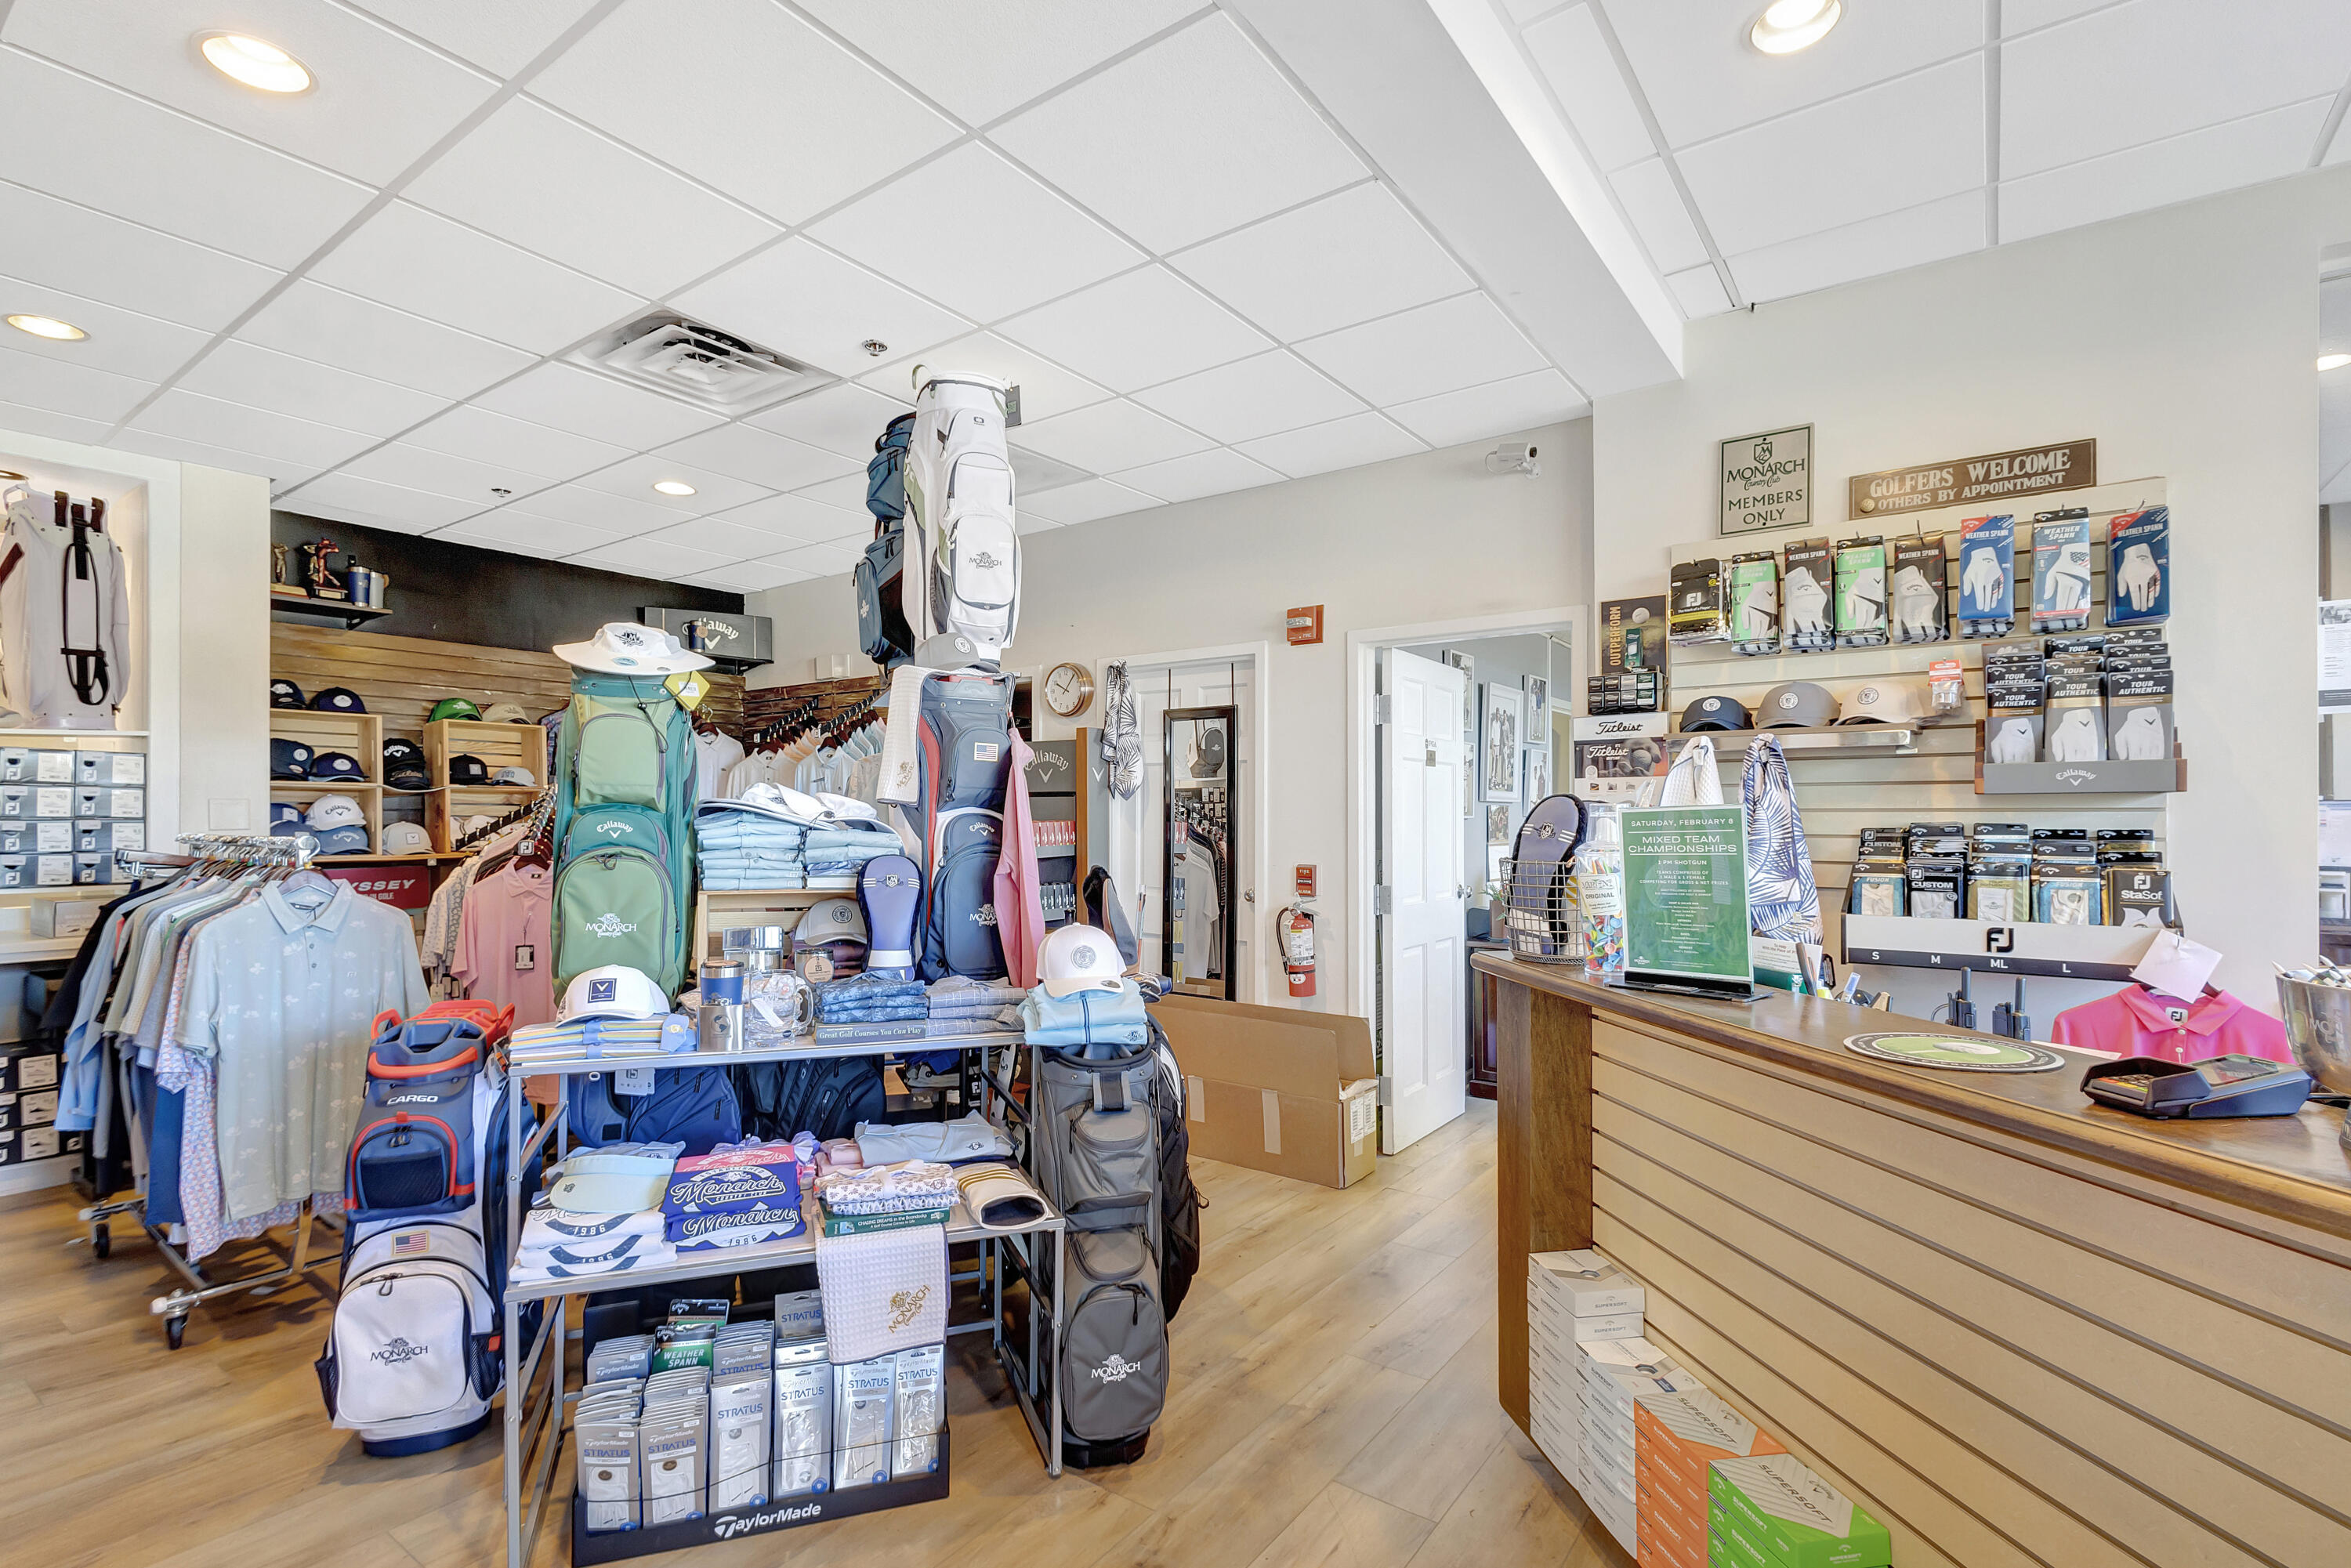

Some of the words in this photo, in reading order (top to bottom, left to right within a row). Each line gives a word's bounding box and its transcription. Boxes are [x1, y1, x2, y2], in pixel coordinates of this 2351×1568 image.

[1726, 458, 1805, 483] MONARCH
[1870, 468, 1954, 498] GOLFERS
[1967, 448, 2071, 482] WELCOME
[1744, 479, 1766, 491] Country
[1767, 476, 1780, 487] Club
[1878, 493, 1931, 510] OTHERS
[1937, 488, 1956, 502] BY
[1962, 472, 2067, 498] APPOINTMENT
[1729, 490, 1802, 511] MEMBERS
[1743, 508, 1785, 524] ONLY
[2045, 526, 2080, 534] WEATHER
[2117, 527, 2142, 538] WEATHER
[969, 557, 1002, 566] MONARCH
[1686, 592, 1701, 607] FJ
[1610, 606, 1621, 666] OUTPERFORM
[1596, 721, 1643, 734] Titleist
[1587, 744, 1629, 759] Titleist
[6, 768, 21, 780] FJ
[84, 770, 96, 781] FJ
[2056, 768, 2097, 780] Callaway
[5, 802, 20, 814] FJ
[82, 803, 95, 814] FJ
[325, 805, 352, 815] Callaway
[596, 820, 633, 833] Callaway
[969, 822, 994, 833] Callaway
[1865, 831, 1874, 839] FJ
[5, 838, 20, 851] FJ
[82, 838, 96, 849] FJ
[521, 844, 531, 853] FJ
[5, 872, 20, 884] FJ
[80, 870, 96, 883] FJ
[2134, 875, 2150, 889] FJ
[2121, 890, 2162, 900] StaSof
[585, 923, 636, 932] MONARCH
[1987, 928, 2014, 953] FJ
[1872, 951, 1879, 960] S
[1931, 955, 1940, 964] M
[1991, 958, 2008, 969] ML
[2063, 963, 2070, 972] L
[2170, 1010, 2183, 1023] FJ
[386, 1095, 438, 1105] CARGO
[700, 1166, 763, 1178] ESTABLISHED
[671, 1175, 786, 1204] Monarch
[572, 1224, 606, 1237] 1986
[728, 1234, 757, 1247] 1986
[1542, 1274, 1560, 1291] SUPERSOFT
[781, 1309, 821, 1323] STRATUS
[889, 1285, 931, 1334] MONARCH
[370, 1345, 428, 1361] MONARCH
[664, 1349, 705, 1360] WEATHER
[722, 1353, 763, 1365] TaylorMade
[668, 1357, 698, 1367] SPANN
[721, 1363, 763, 1374] STRATUS
[596, 1363, 639, 1376] TaylorMade
[898, 1368, 937, 1380] STRATUS
[1092, 1361, 1140, 1378] MONARCH
[848, 1378, 889, 1389] STRATUS
[1591, 1367, 1614, 1389] SUPERSOFT
[781, 1387, 824, 1401] STRATUS
[718, 1403, 763, 1418] STRATUS
[1592, 1393, 1614, 1417] SUPERSOFT
[1677, 1397, 1737, 1444] SUPERSOFT
[649, 1429, 694, 1443] TaylorMade
[1592, 1419, 1614, 1443] SUPERSOFT
[648, 1438, 696, 1454] STRATUS
[1654, 1426, 1680, 1452] SUPERSOFT
[1592, 1444, 1614, 1468] SUPERSOFT
[1654, 1454, 1682, 1482] SUPERSOFT
[1655, 1483, 1683, 1511] SUPERSOFT
[1758, 1464, 1832, 1523] SUPERSOFT
[1733, 1496, 1767, 1530] SUPERSOFT
[715, 1503, 821, 1540] TaylorMade
[1654, 1511, 1681, 1540] SUPERSOFT
[1731, 1529, 1766, 1564] SUPERSOFT
